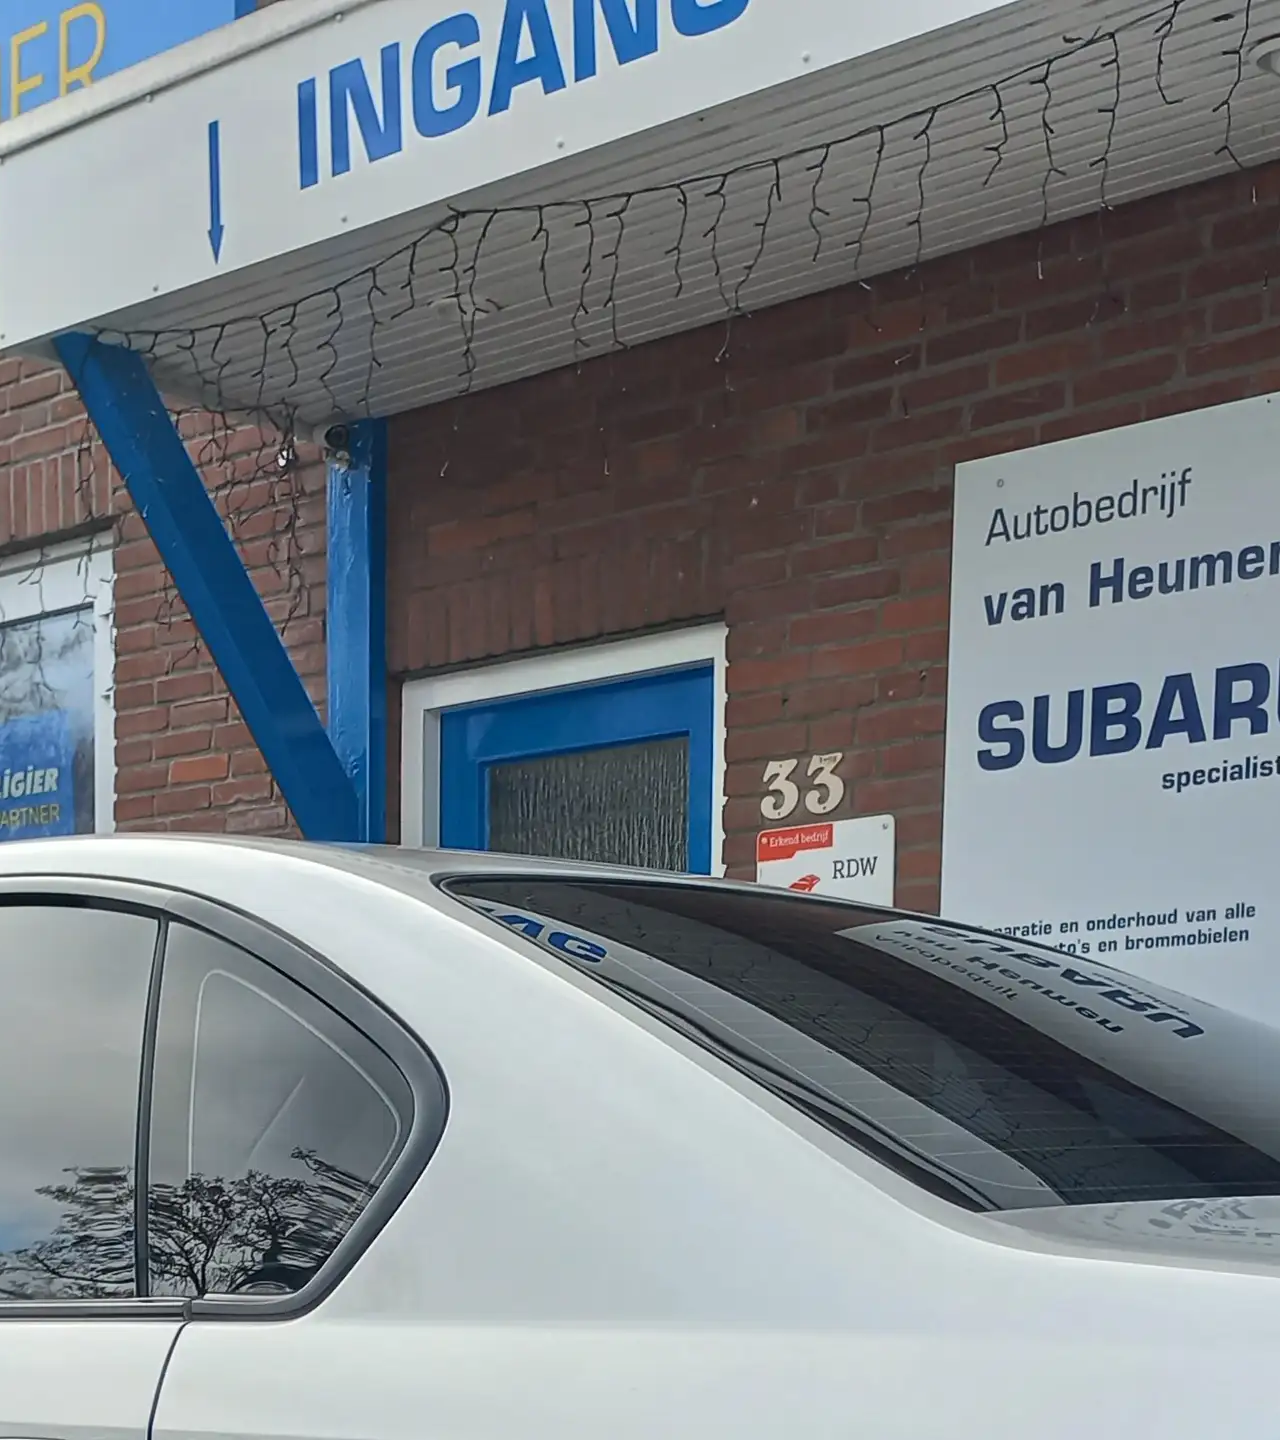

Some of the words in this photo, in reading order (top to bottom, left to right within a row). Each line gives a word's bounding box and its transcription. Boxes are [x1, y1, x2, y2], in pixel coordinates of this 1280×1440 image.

[984, 467, 1192, 546] Autobedrijf
[983, 580, 1065, 626] van
[760, 752, 845, 820] 33
[769, 835, 799, 848] Erkend
[801, 830, 829, 844] bedrijf
[832, 856, 879, 880] RDW
[977, 919, 1053, 937] aratie
[1059, 920, 1079, 934] en
[1086, 908, 1178, 932] onderhoud
[1185, 907, 1217, 925] van
[1224, 902, 1256, 919] alle
[1054, 938, 1091, 954] to's
[1097, 939, 1118, 953] en
[1124, 927, 1249, 951] brommobielen
